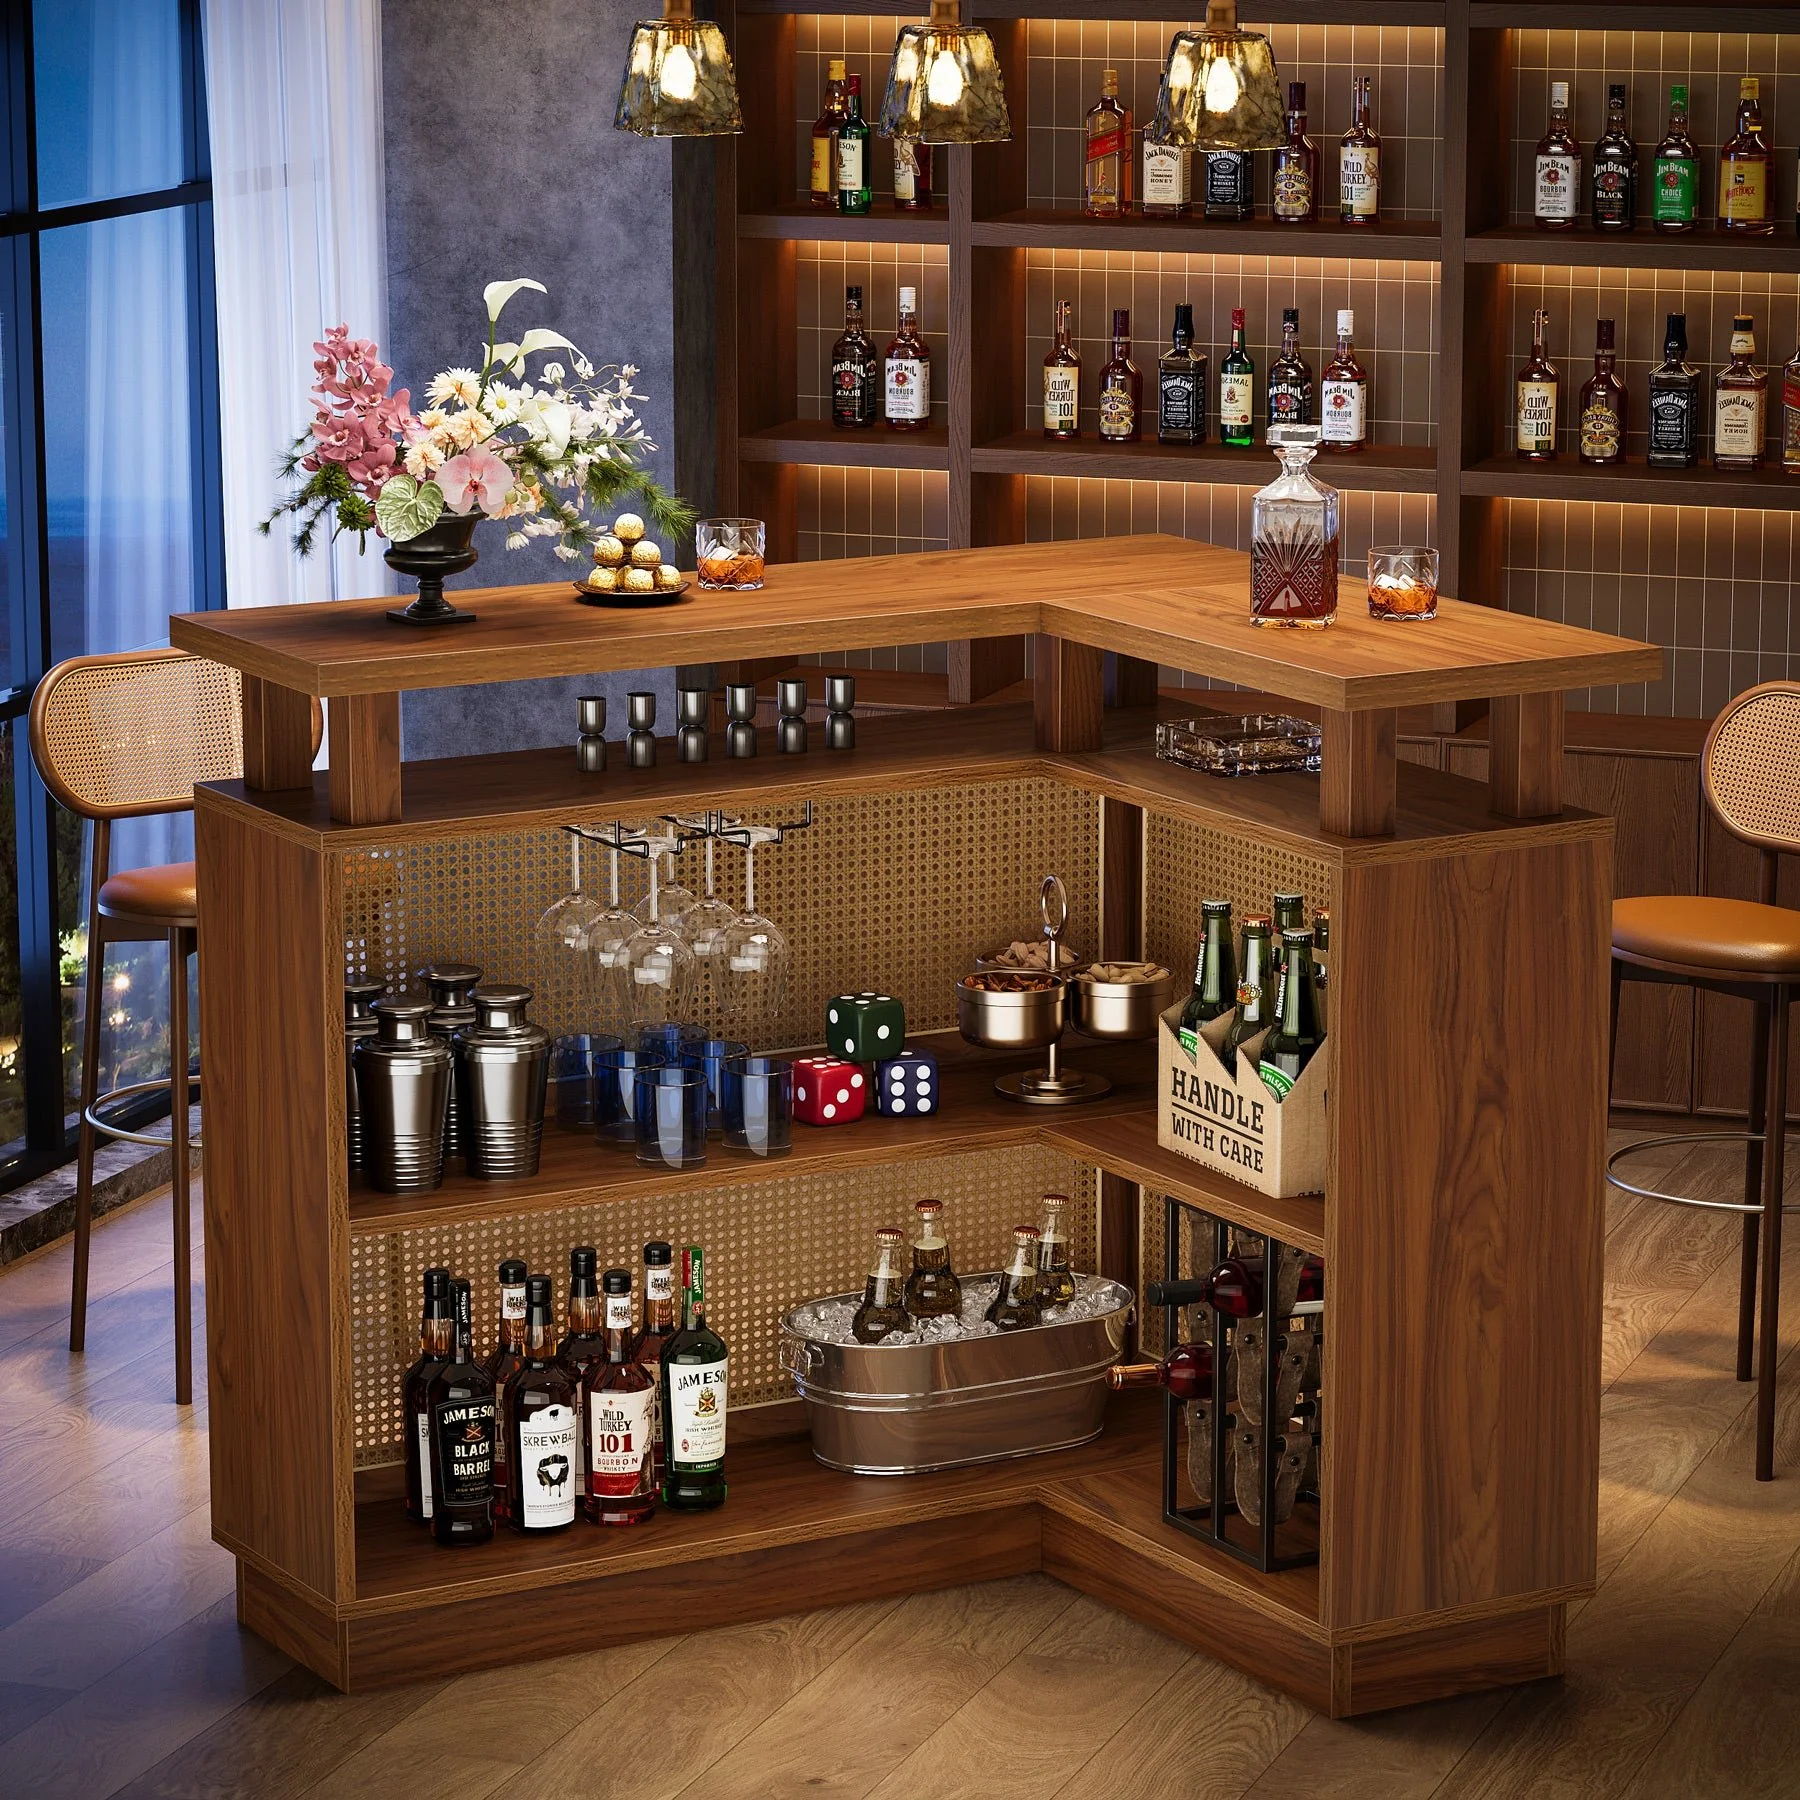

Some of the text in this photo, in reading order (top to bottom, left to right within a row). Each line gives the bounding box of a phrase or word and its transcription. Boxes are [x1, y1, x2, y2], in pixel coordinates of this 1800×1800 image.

[1145, 150, 1158, 161] JACK
[1207, 152, 1221, 164] JACK
[1344, 160, 1362, 173] WILD
[1537, 159, 1570, 174] JIM BEAM
[1593, 161, 1629, 178] JIM BEAM
[1656, 162, 1689, 177] JIM BEAM
[1341, 170, 1367, 185] TURKEY
[1341, 185, 1354, 201] 101
[1539, 185, 1567, 193] BOURBON
[1596, 190, 1623, 199] BLACK
[1660, 188, 1682, 197] CHOICE
[1194, 942, 1205, 986] Heineken
[1275, 973, 1286, 1018] Heineken
[1171, 1066, 1264, 1135] HANDLE
[1171, 1112, 1215, 1152] WITH
[1219, 1134, 1264, 1174] CARE
[692, 1259, 701, 1294] JAMESON
[602, 1409, 624, 1421] WILD
[599, 1417, 632, 1433] TURKEY
[454, 1440, 490, 1458] BLACK
[599, 1432, 634, 1454] 101
[453, 1459, 491, 1476] BARREL
[597, 1457, 638, 1466] BOURBON
